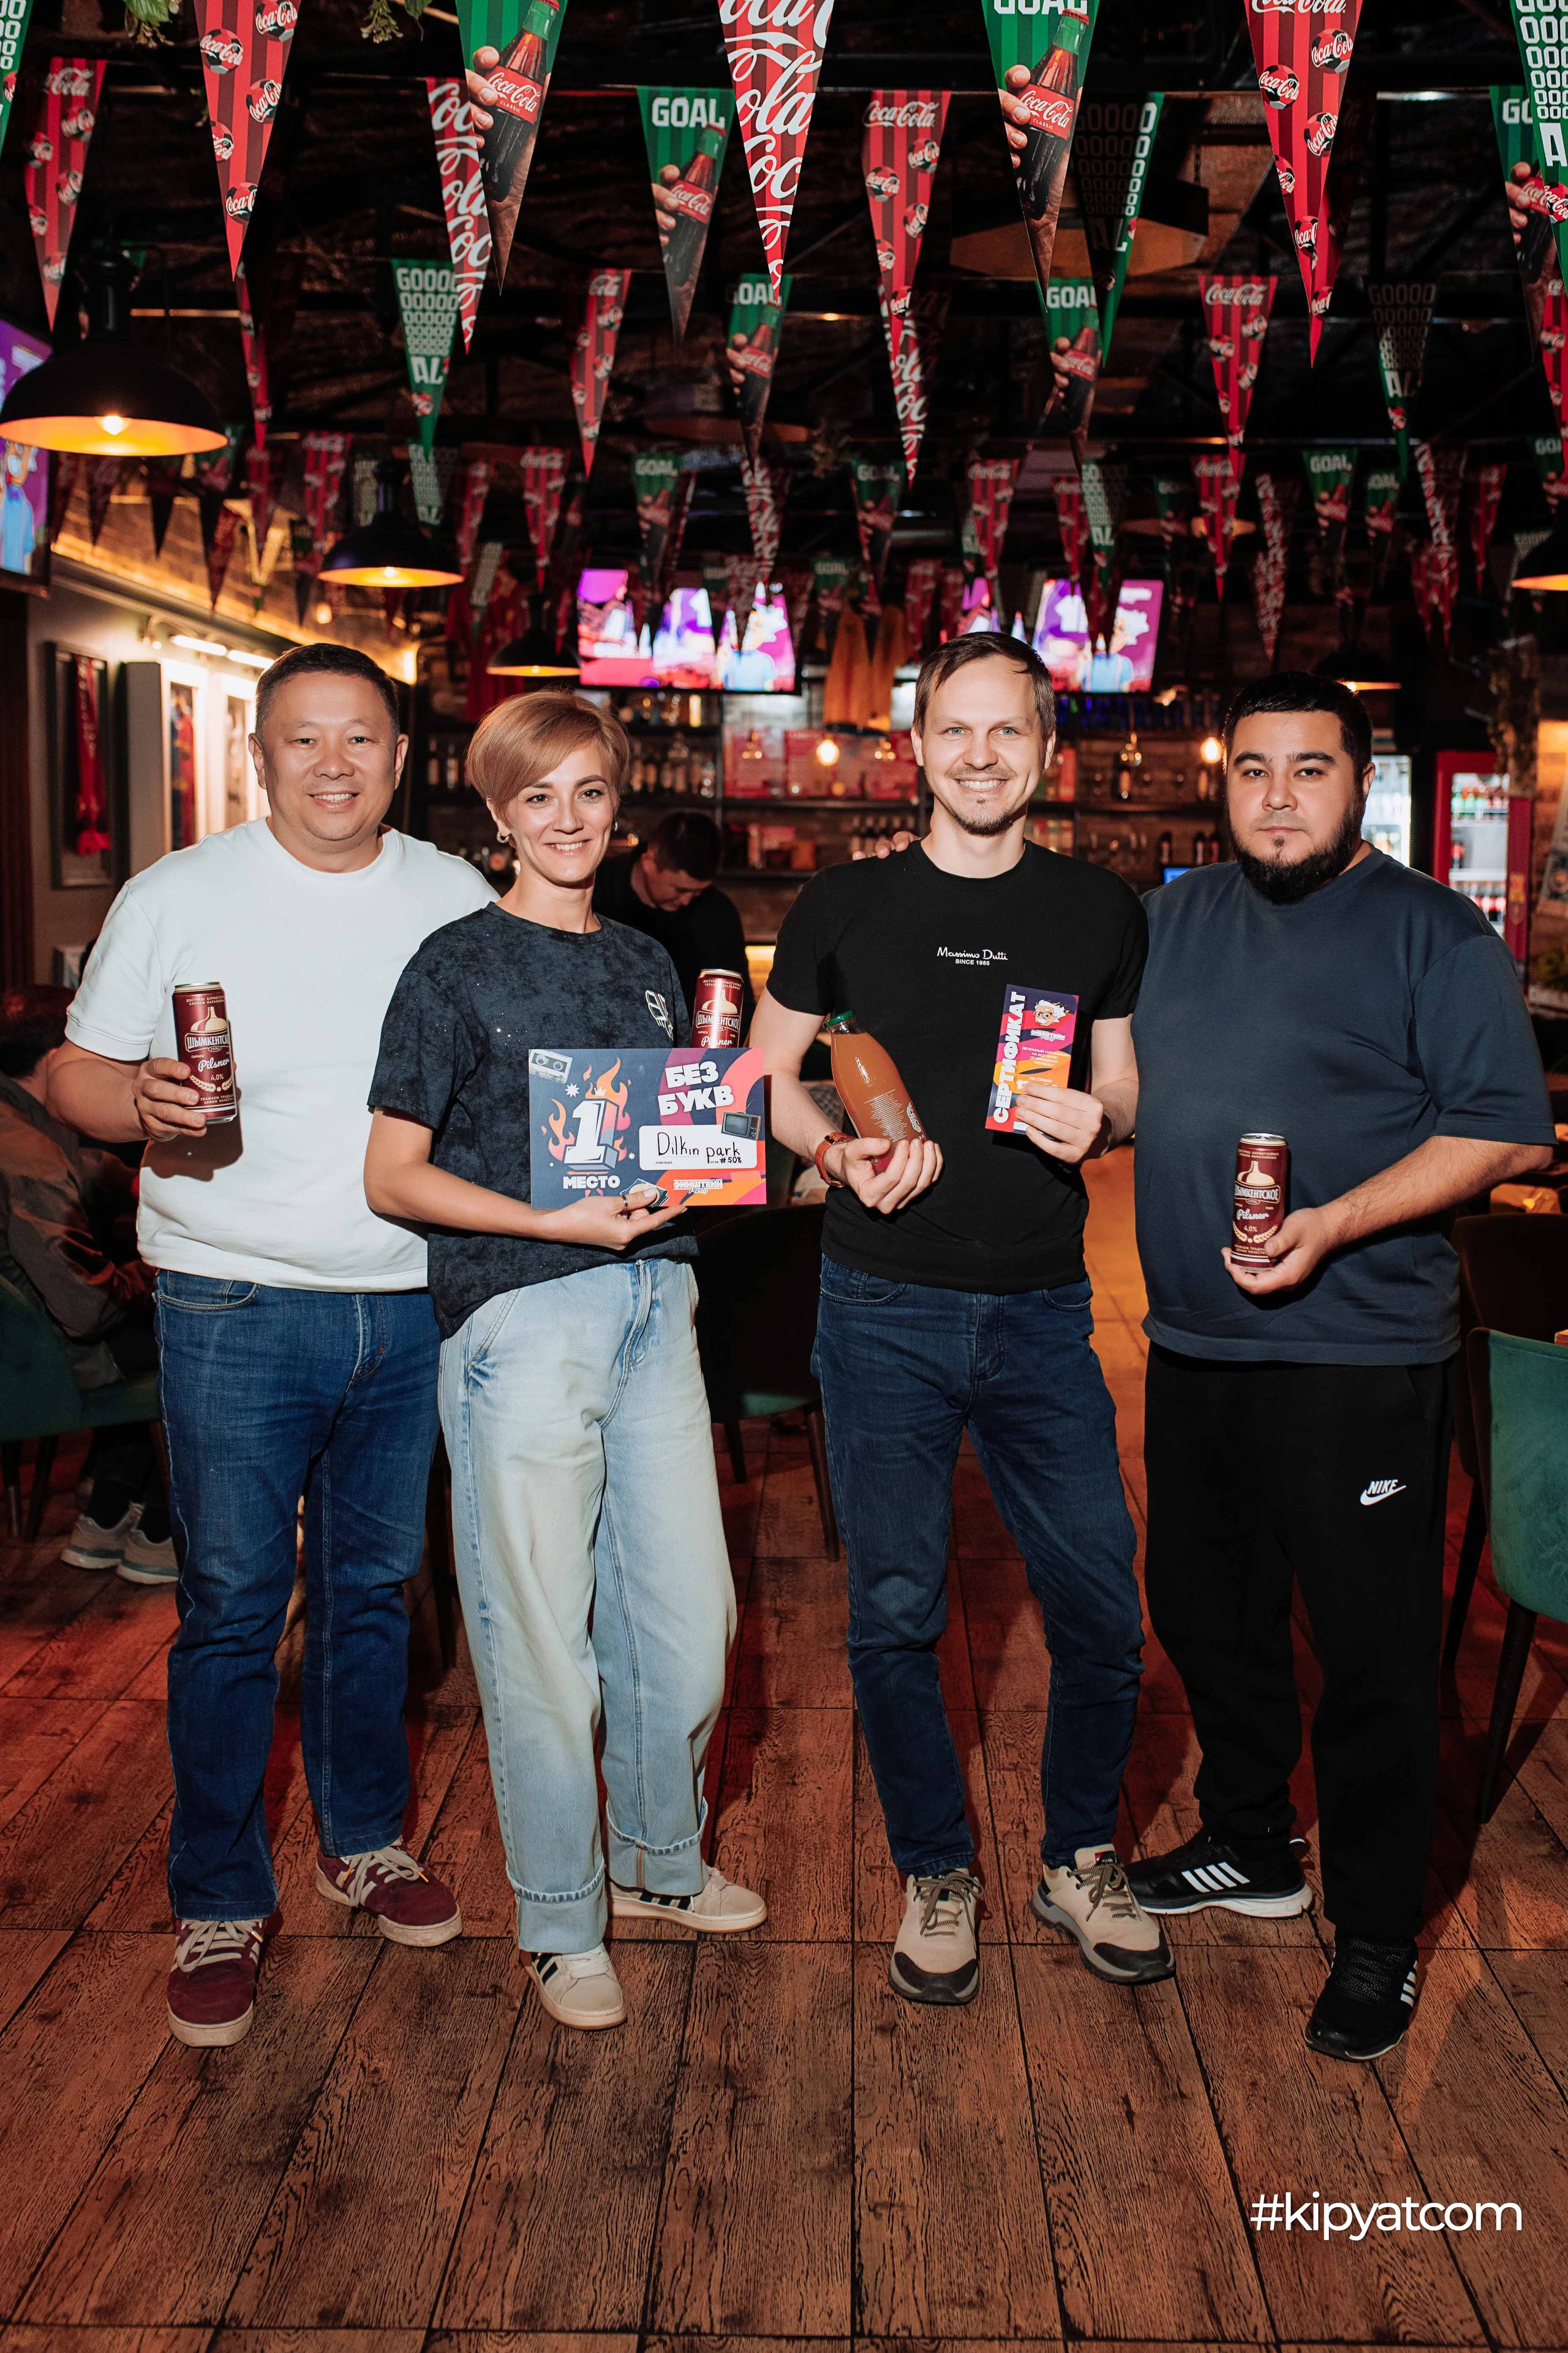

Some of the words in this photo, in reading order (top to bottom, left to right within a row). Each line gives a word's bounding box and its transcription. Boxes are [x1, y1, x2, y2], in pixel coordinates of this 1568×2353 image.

[500, 100, 521, 114] CLASSIC
[652, 97, 726, 128] GOAL
[862, 100, 940, 127] Coca-Cola
[1033, 118, 1054, 130] CLASSIC
[1205, 283, 1268, 306] Coca-Cola
[937, 946, 980, 959] Massimo
[982, 949, 1009, 961] Dutti
[197, 1057, 230, 1073] Pilsner
[993, 991, 1025, 1124] СЕРТИФИКАТ
[665, 1060, 720, 1089] БЕЗ
[657, 1084, 735, 1117] БУКВ
[706, 1141, 741, 1164] park
[562, 1174, 621, 1190] МЕСТО
[1236, 1209, 1270, 1220] Pilsner
[1366, 1479, 1398, 1495] NIKE
